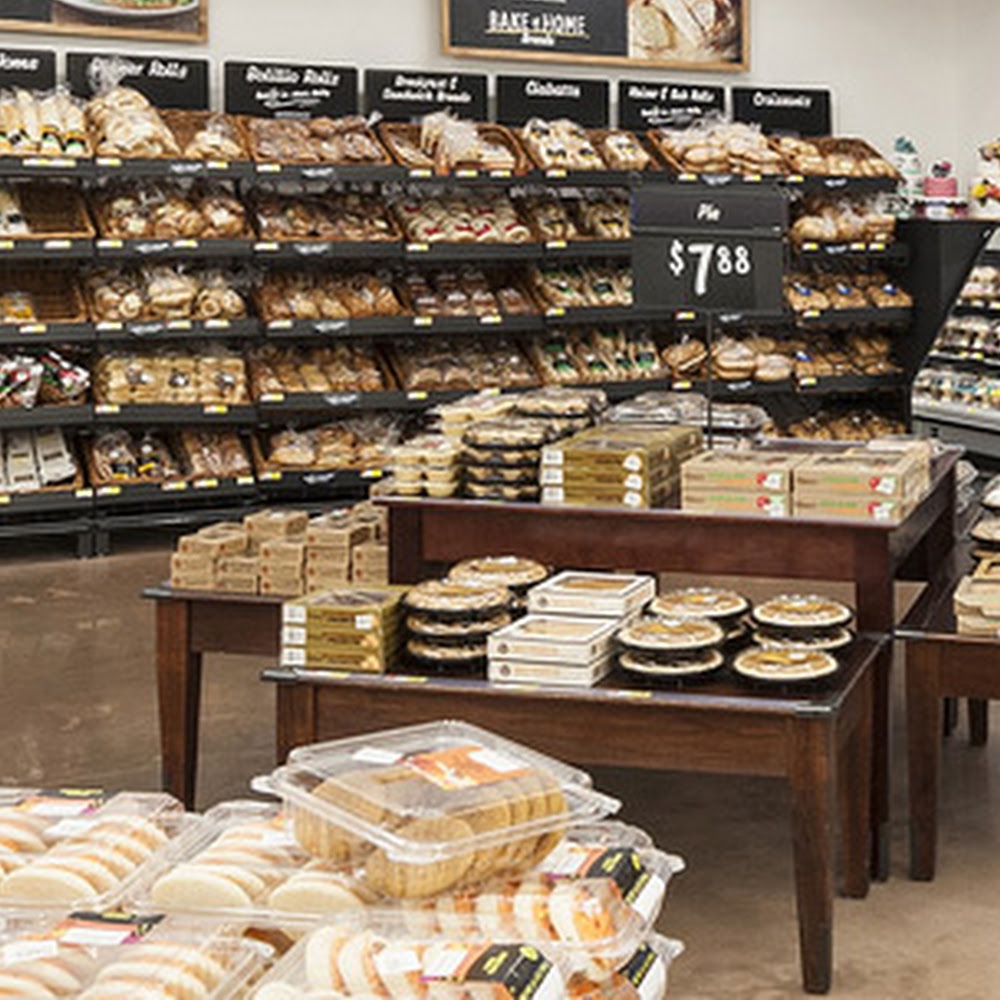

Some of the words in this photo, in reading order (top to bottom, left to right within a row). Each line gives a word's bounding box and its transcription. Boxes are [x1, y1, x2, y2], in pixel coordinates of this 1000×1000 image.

[489, 10, 530, 30] BAKE
[542, 12, 587, 34] HOME
[302, 68, 341, 87] Rolls
[696, 202, 722, 222] Pie
